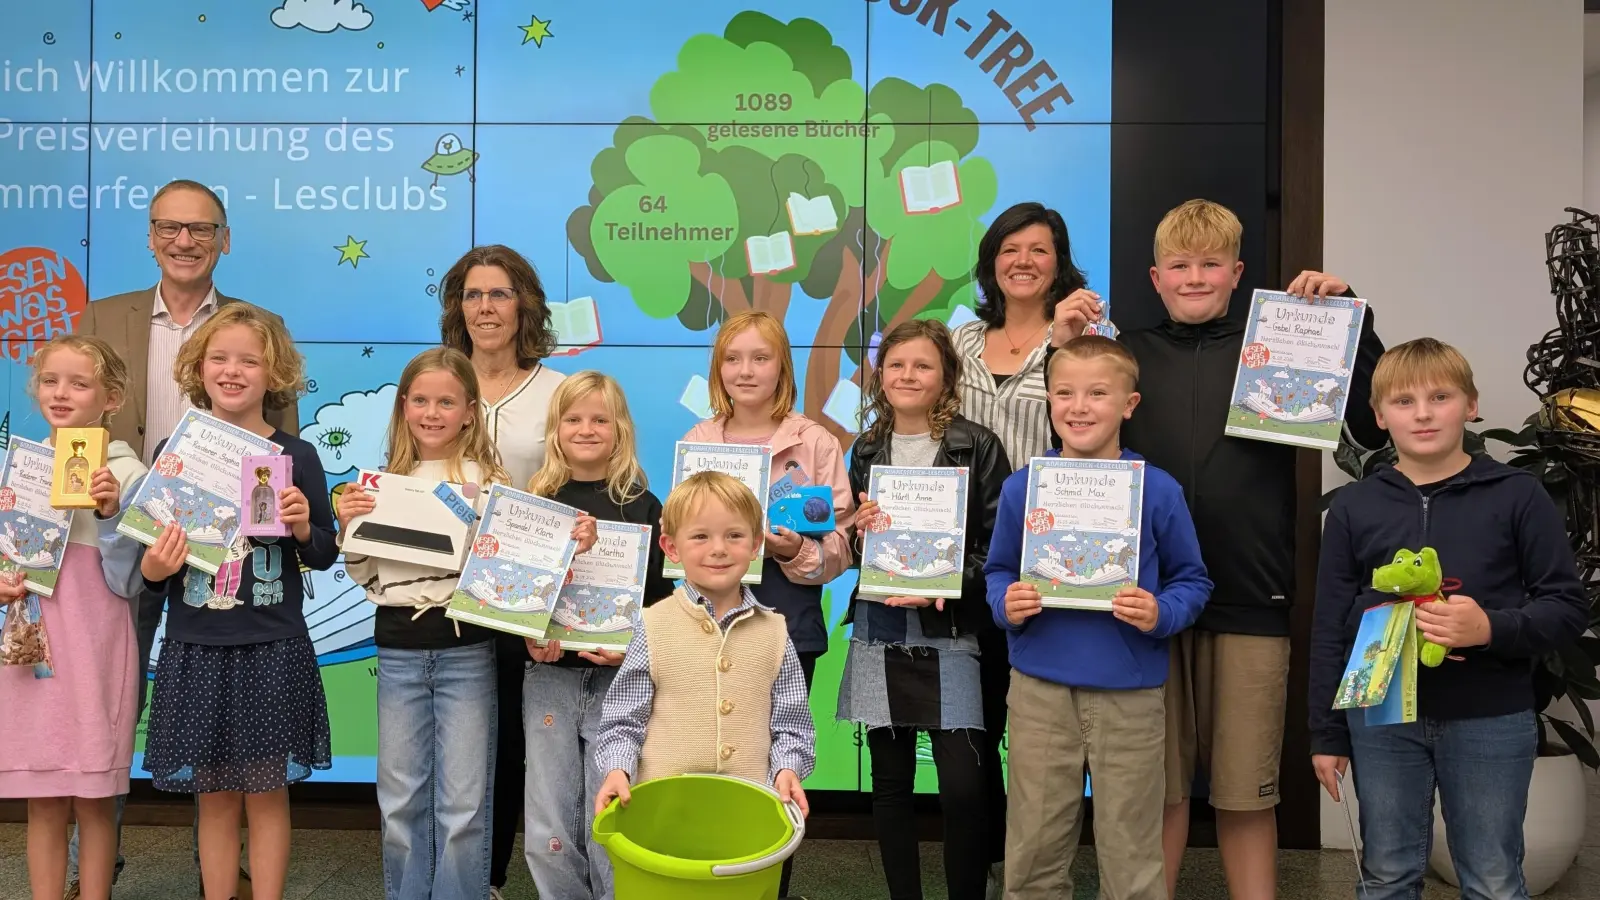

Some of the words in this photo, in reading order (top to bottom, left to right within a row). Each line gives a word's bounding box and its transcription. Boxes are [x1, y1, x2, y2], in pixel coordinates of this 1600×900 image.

[74, 59, 328, 94] Willkommen
[345, 67, 409, 93] zur
[735, 93, 793, 112] 1089
[324, 116, 394, 152] des
[707, 120, 799, 142] gelesene
[805, 120, 880, 139] Bücher
[274, 176, 448, 211] Lesclubs
[639, 195, 668, 214] 64
[604, 222, 734, 241] Teilnehmer
[1276, 307, 1336, 325] Urkunde
[1294, 323, 1323, 336] Raphael
[200, 428, 252, 456] Urkunde
[697, 456, 749, 470] Urkunde
[892, 479, 945, 492] Urkunde
[1054, 472, 1116, 487] Urkunde
[1054, 487, 1082, 496] Schmid
[1087, 488, 1106, 497] Max
[446, 492, 475, 524] Preis
[509, 503, 561, 529] Urkunde
[535, 526, 554, 539] Klara
[598, 547, 625, 558] Martha
